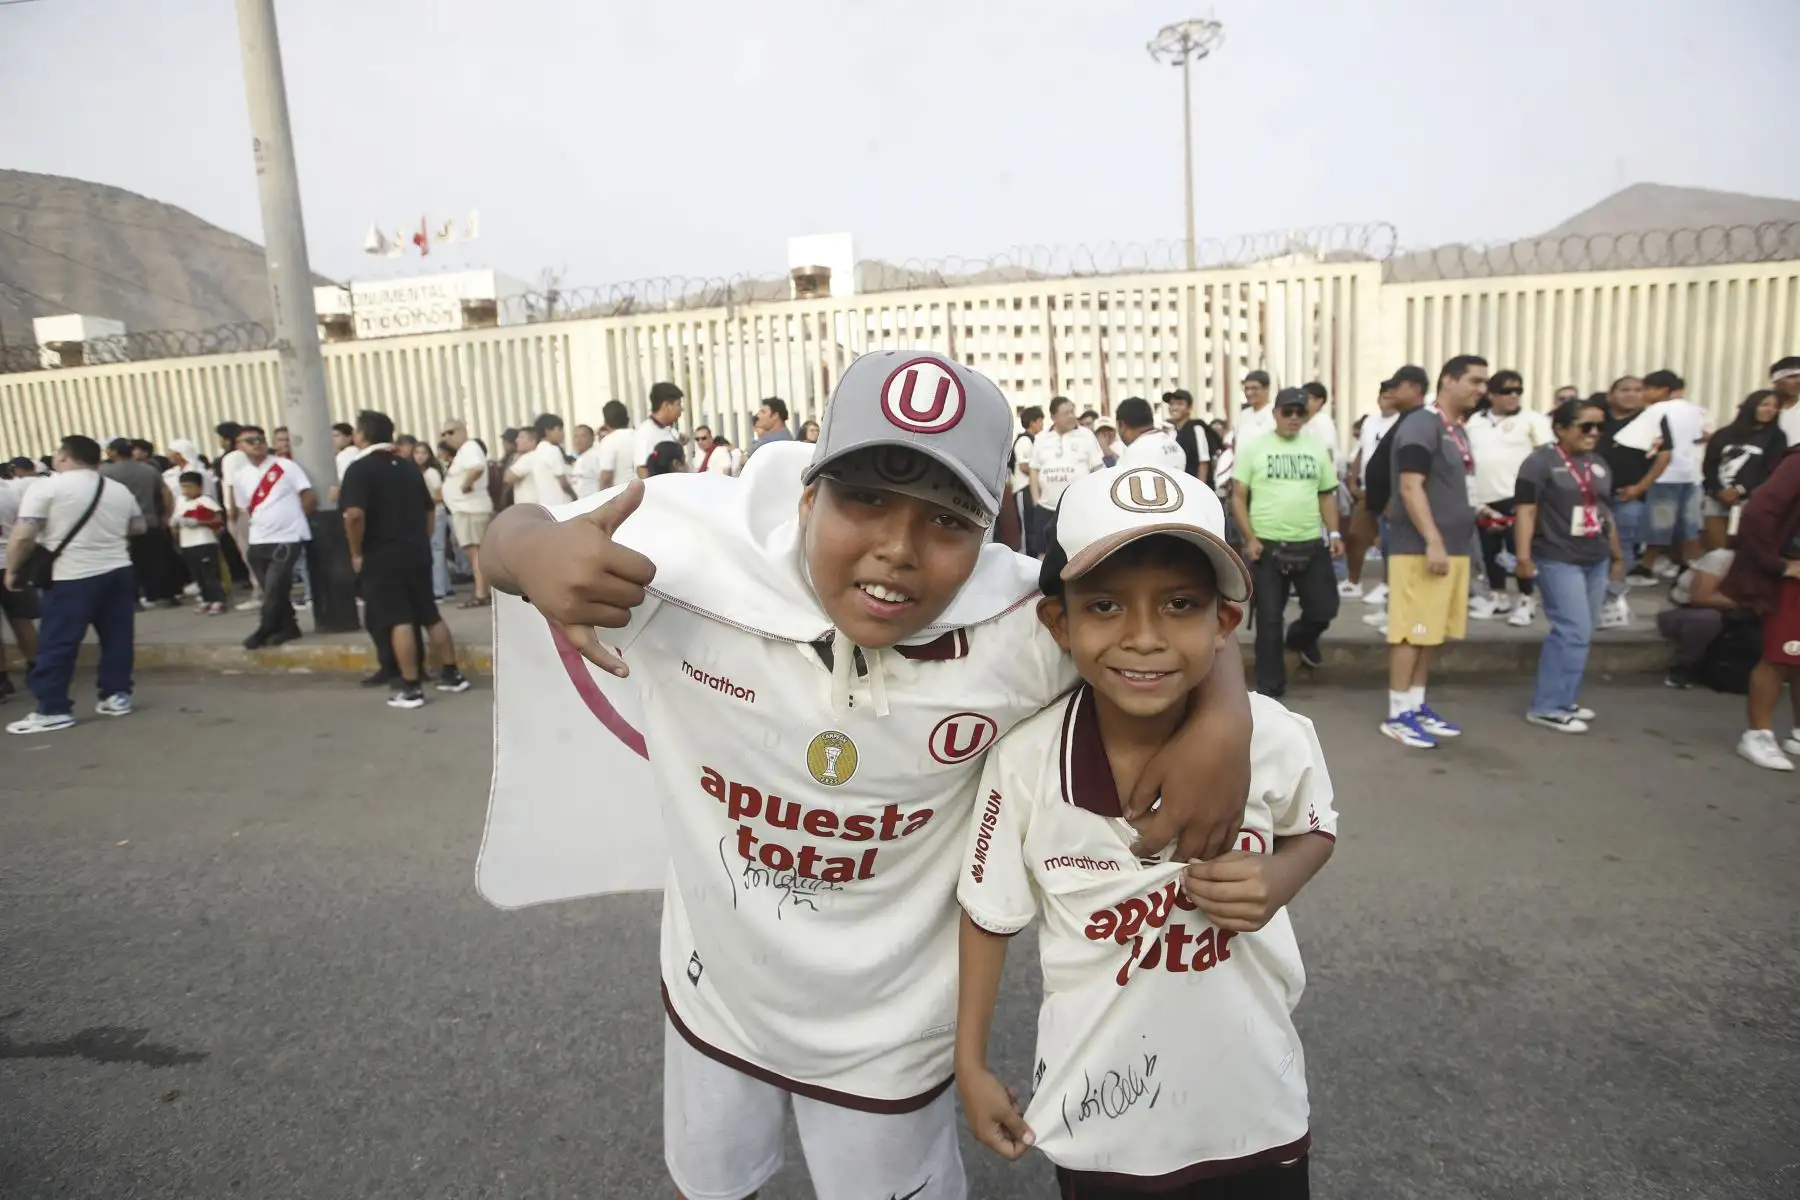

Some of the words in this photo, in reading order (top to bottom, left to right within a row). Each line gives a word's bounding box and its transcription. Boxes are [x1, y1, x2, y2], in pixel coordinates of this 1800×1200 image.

[899, 369, 951, 422] U
[1129, 476, 1169, 507] U
[682, 660, 756, 703] marathon
[943, 723, 986, 758] U
[700, 765, 935, 842] apuesta
[975, 789, 1002, 865] MOVISUN
[737, 824, 879, 883] total
[1044, 855, 1121, 872] marathon
